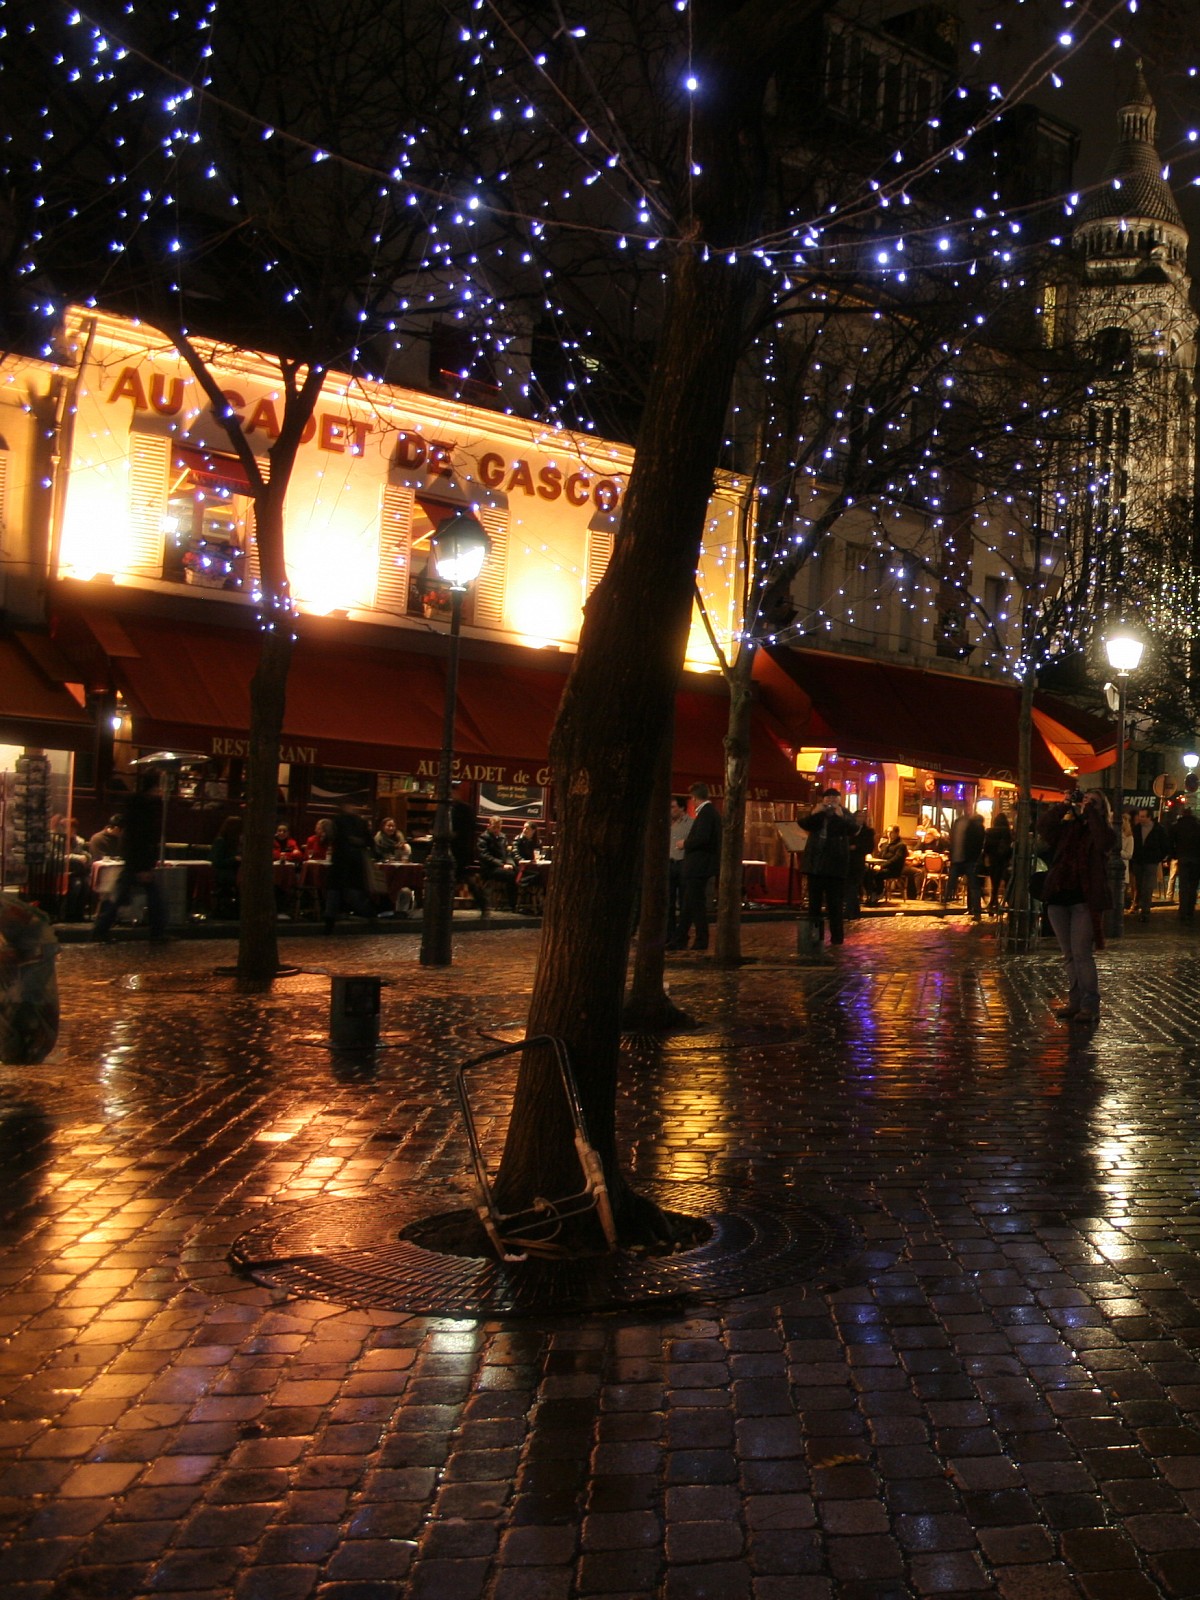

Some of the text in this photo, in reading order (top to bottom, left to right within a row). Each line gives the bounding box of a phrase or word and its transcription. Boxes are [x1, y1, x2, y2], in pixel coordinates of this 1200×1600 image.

[107, 366, 185, 415] AU
[397, 432, 453, 476] DE
[212, 736, 318, 764] RESTRANT
[416, 760, 440, 777] AU
[449, 758, 506, 782] CADET
[513, 769, 530, 784] de
